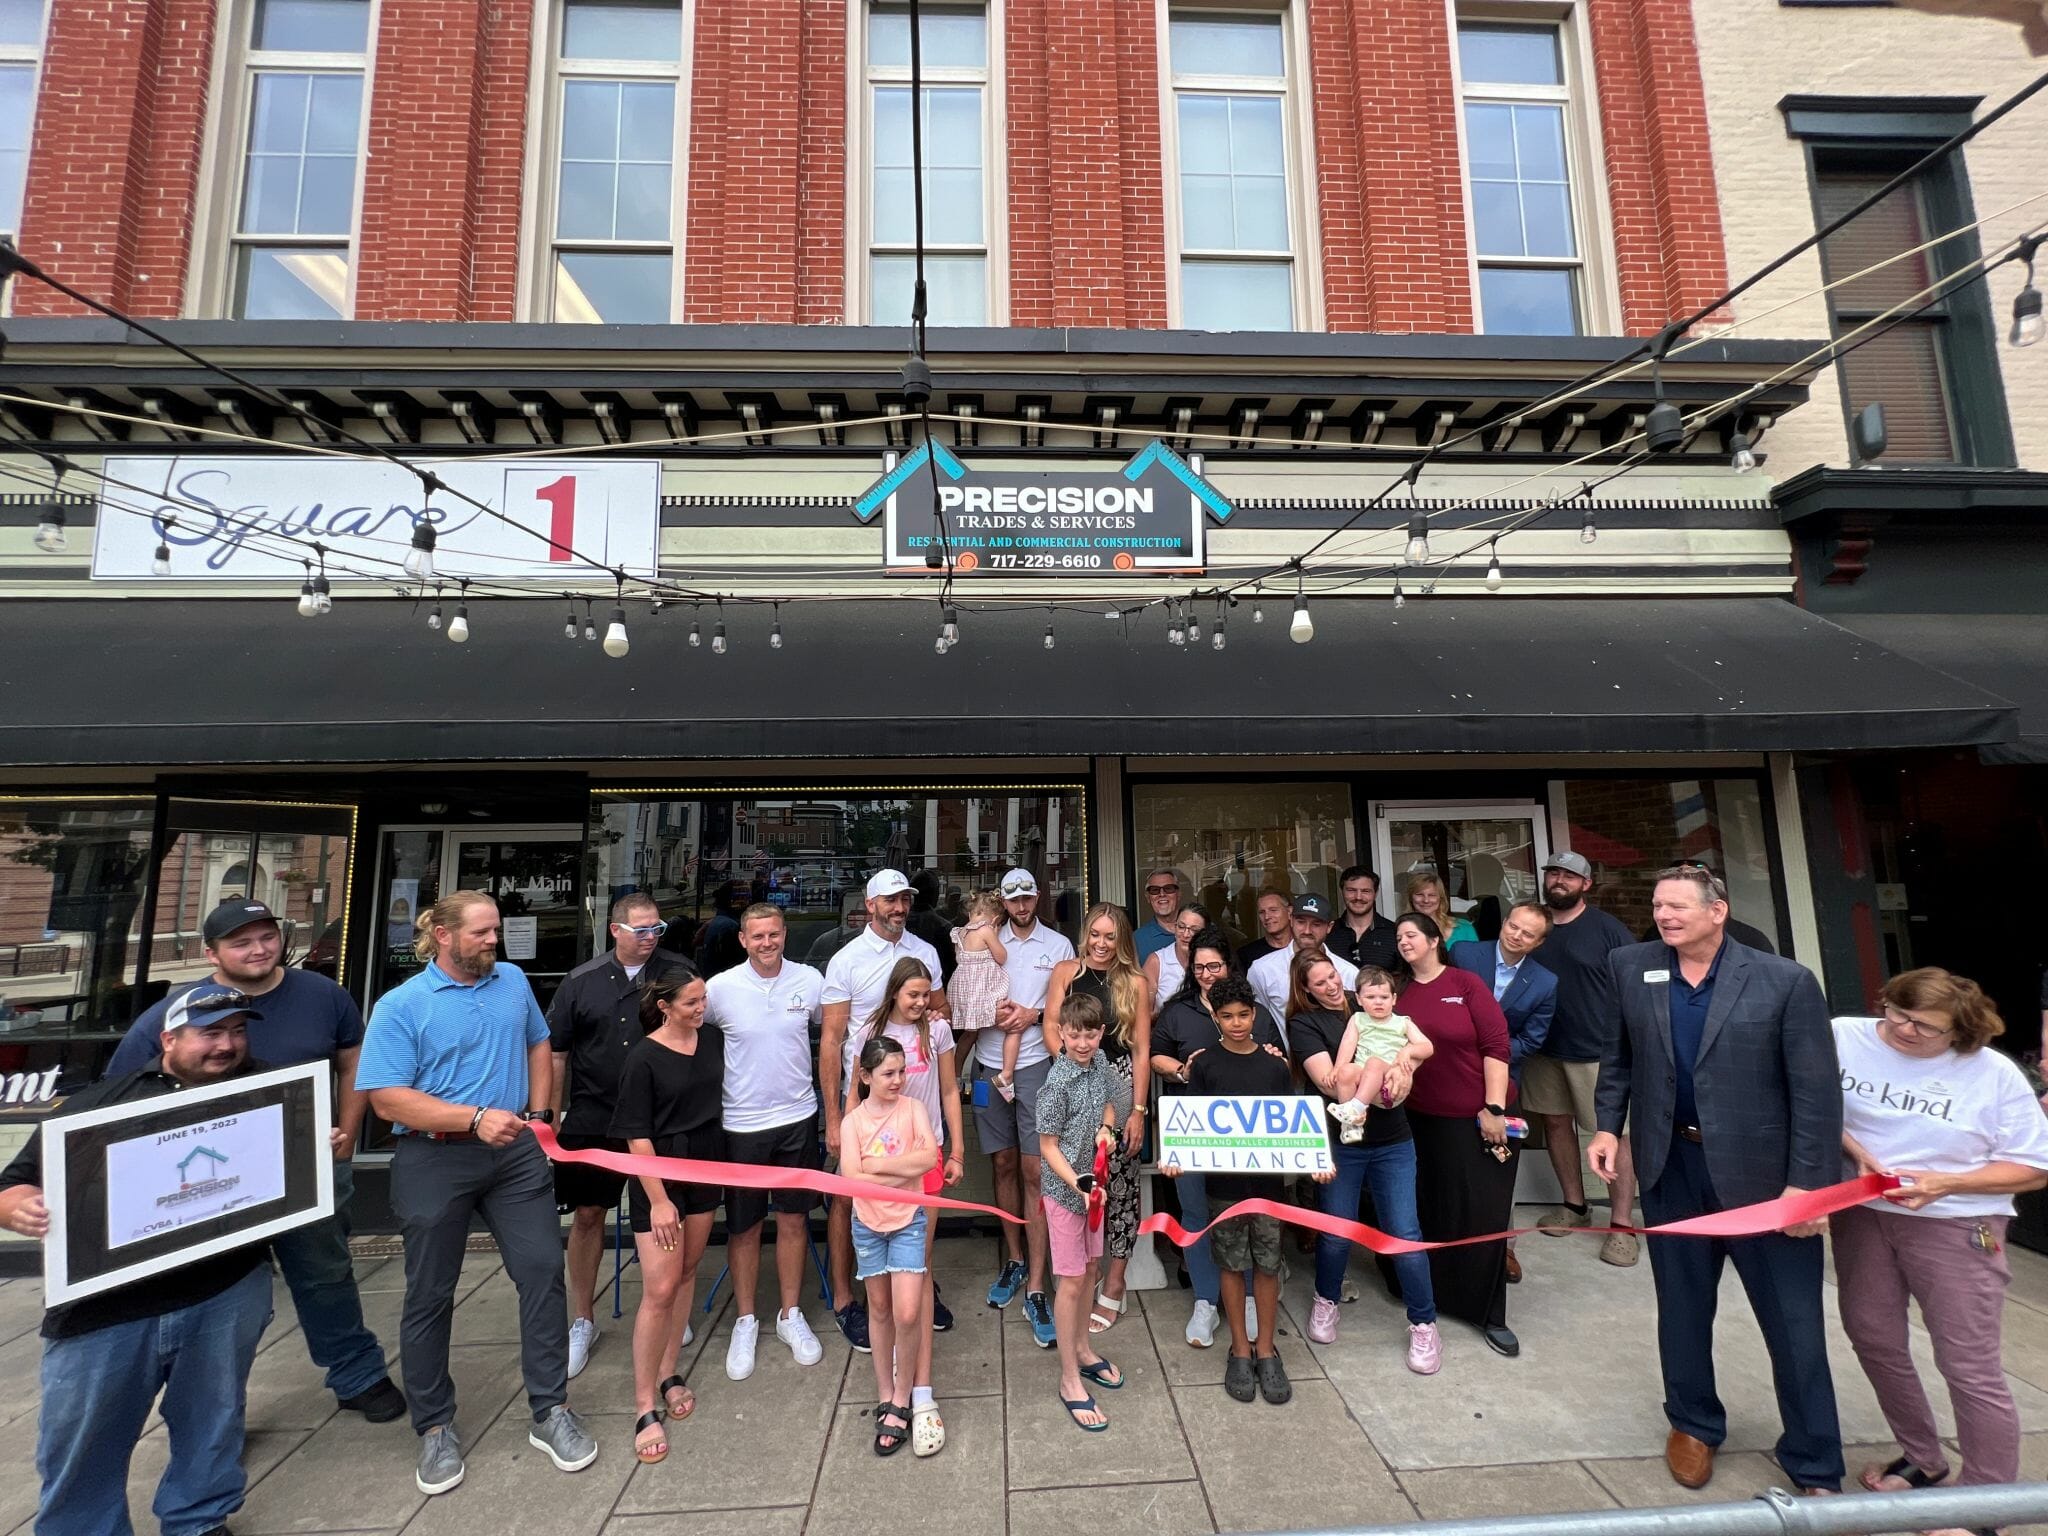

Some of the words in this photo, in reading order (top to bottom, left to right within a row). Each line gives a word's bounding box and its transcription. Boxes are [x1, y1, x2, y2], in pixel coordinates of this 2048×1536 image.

[938, 486, 1153, 513] PRECISION
[152, 470, 492, 570] Square
[536, 475, 576, 561] 1
[956, 515, 1027, 529] TRADES
[1031, 515, 1045, 529] &
[1049, 516, 1135, 529] SERVICES
[988, 536, 1013, 548] AND
[1015, 537, 1091, 548] COMMERCIAL
[1094, 537, 1181, 548] CONSTRUCTION
[990, 554, 1101, 569] 717-229-6610
[528, 874, 572, 892] Main
[0, 1064, 62, 1103] nt
[1840, 1068, 1874, 1099] be
[1880, 1083, 1953, 1122] kind.
[1207, 1099, 1323, 1134] CVBA
[157, 1130, 188, 1145] JUNE
[192, 1126, 208, 1136] 19,
[211, 1118, 238, 1131] 2023
[1170, 1138, 1232, 1146] CUMBERLAND
[1236, 1138, 1269, 1146] VALLEY
[1271, 1139, 1317, 1147] BUSINESS
[1167, 1151, 1328, 1169] ALLIANCE
[156, 1175, 240, 1207] PRECISION
